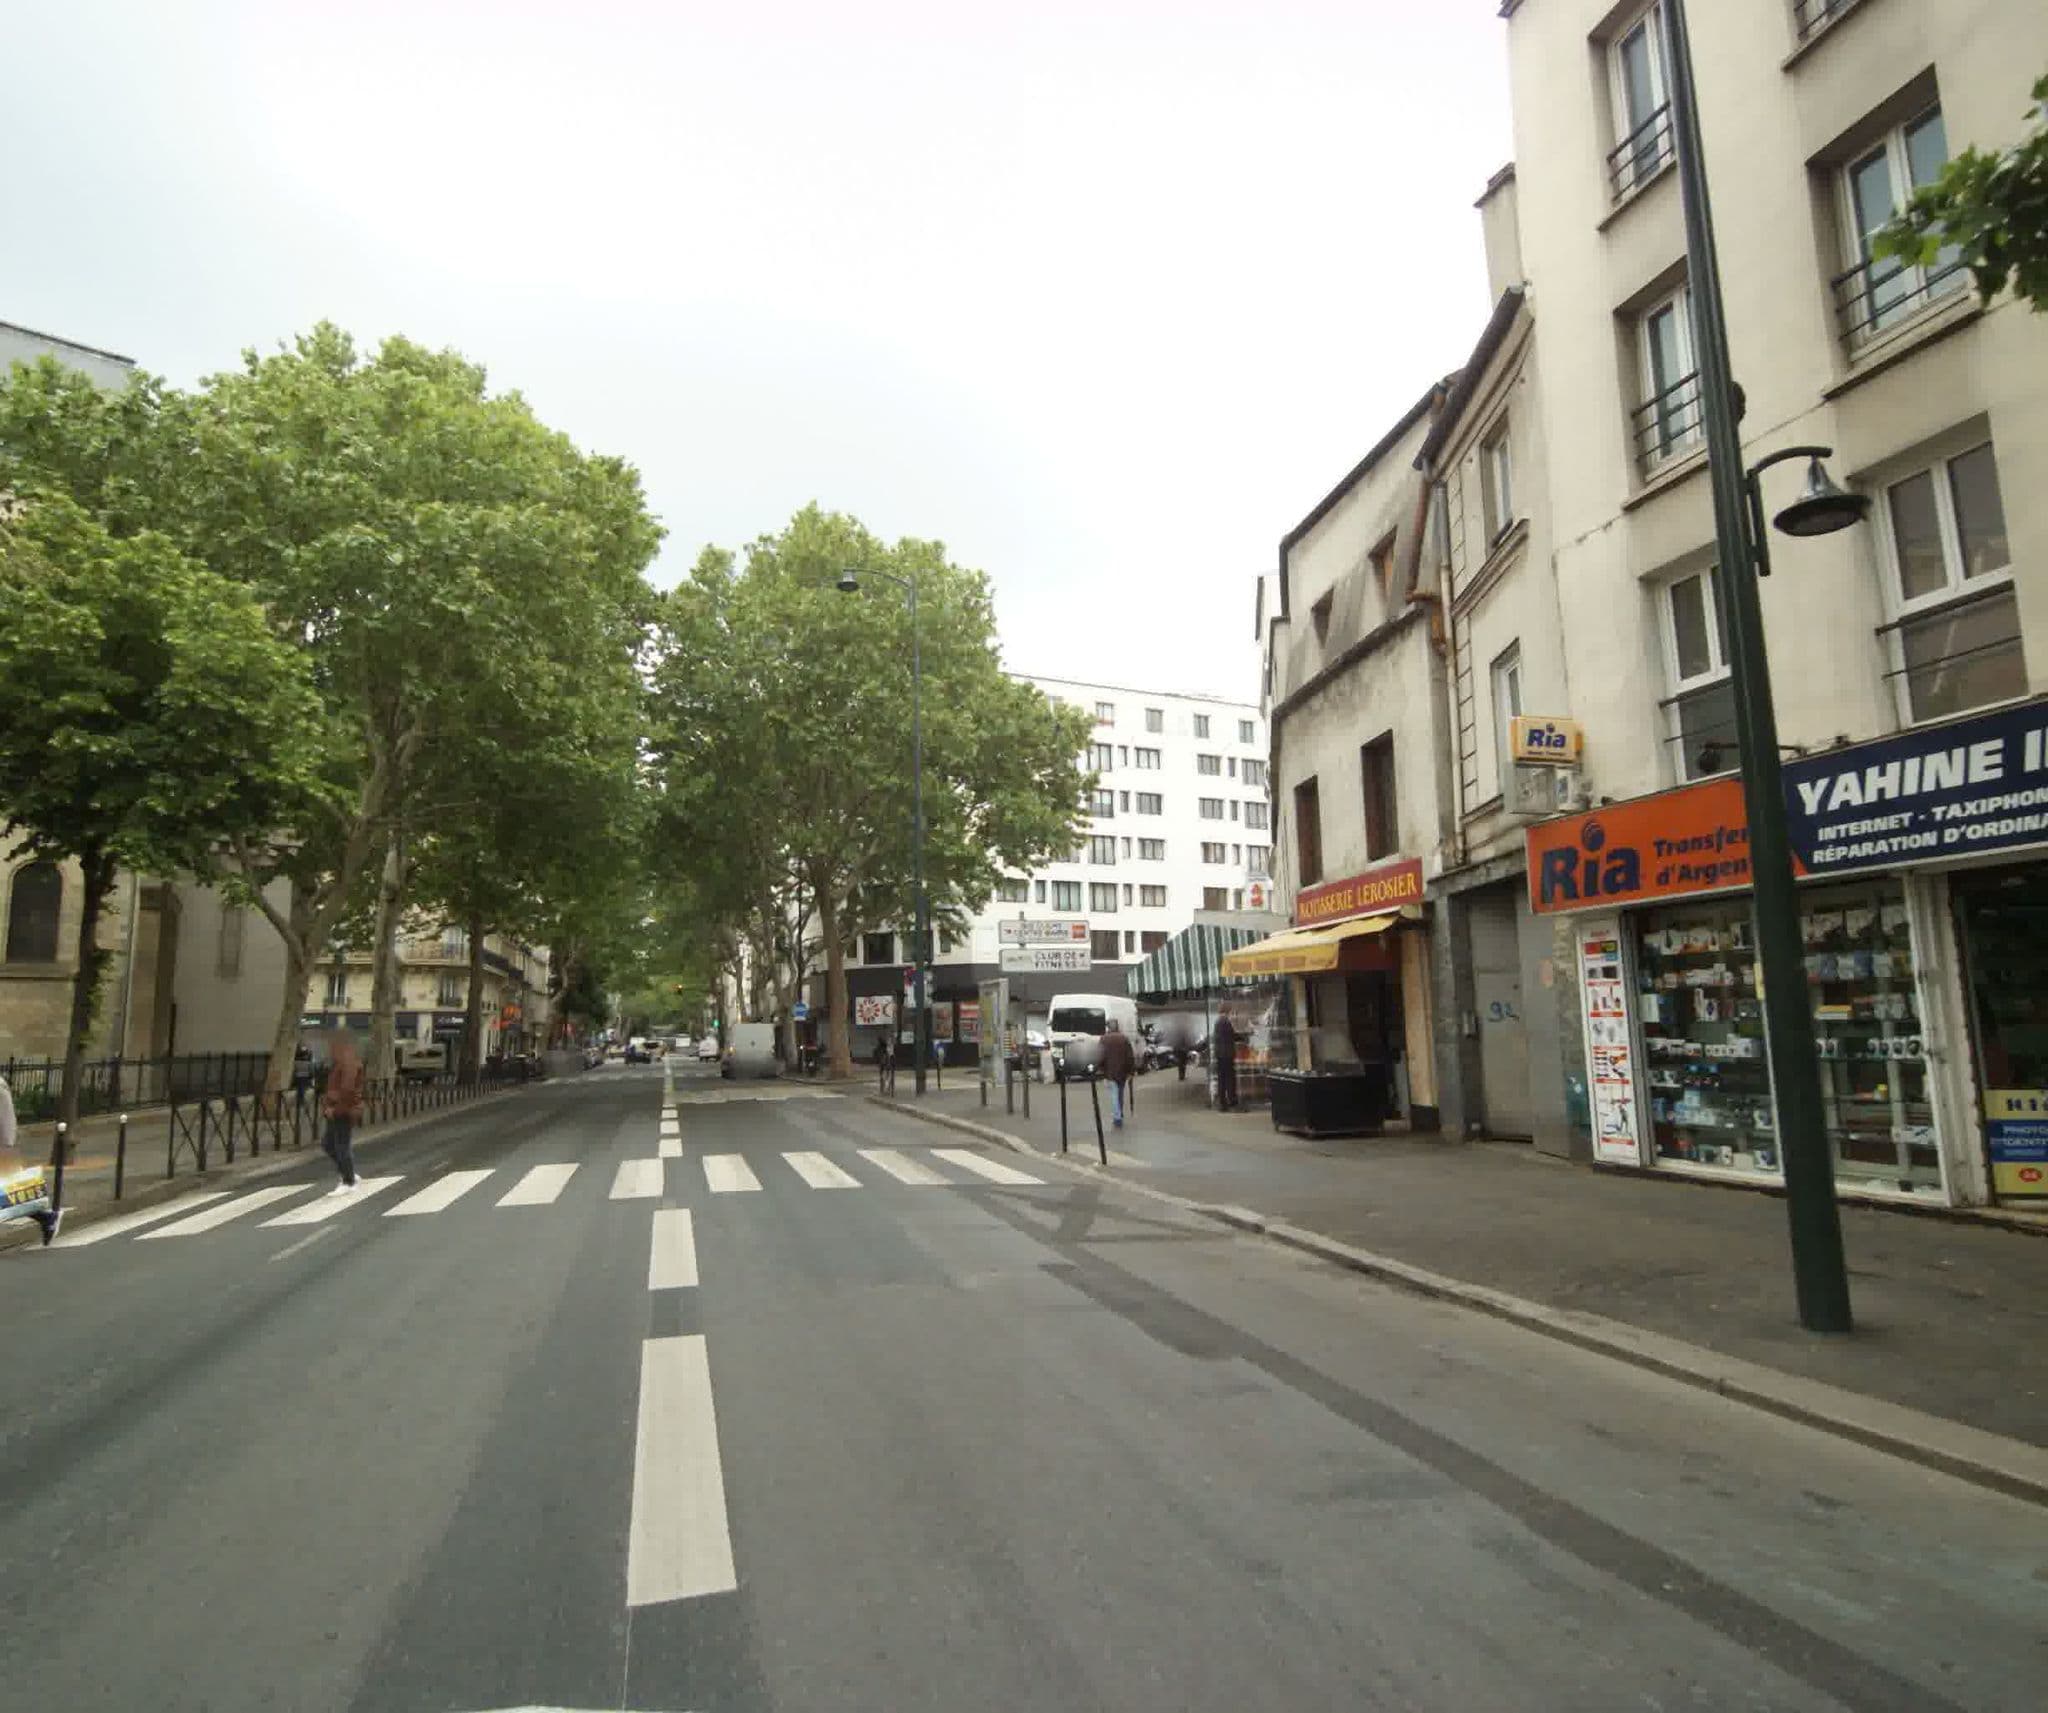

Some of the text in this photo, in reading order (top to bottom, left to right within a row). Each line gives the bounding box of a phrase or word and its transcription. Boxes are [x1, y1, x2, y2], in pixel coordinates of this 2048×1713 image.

[1527, 723, 1566, 748] Ria
[1797, 738, 2004, 815] YAHINE
[1818, 811, 1914, 841] INTERNET
[1541, 819, 1641, 904] Ria
[1813, 830, 1937, 864] RÉPARATION
[1656, 858, 1753, 885] d'Argen
[1357, 873, 1418, 906] LEROSIER
